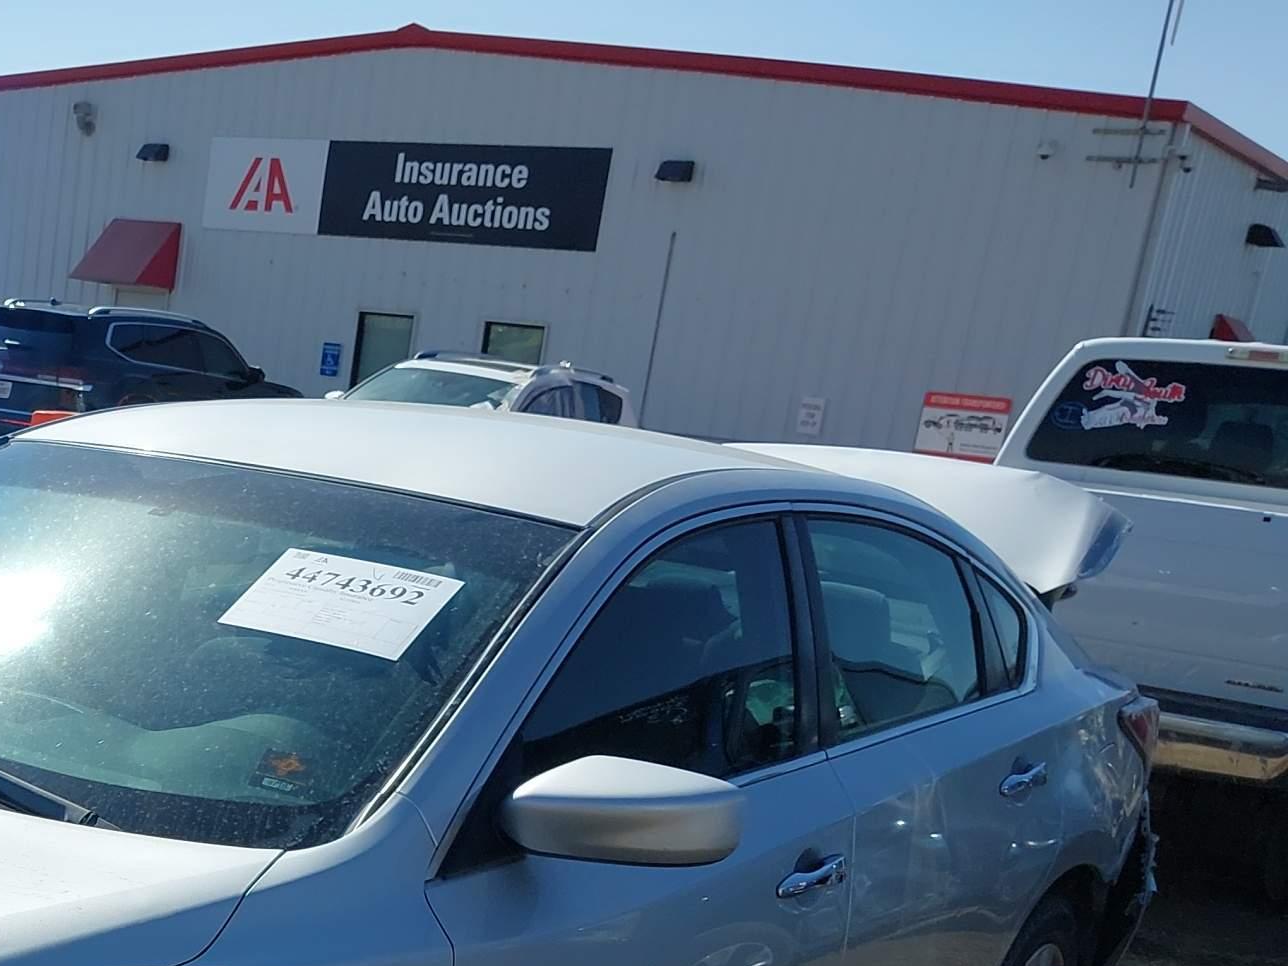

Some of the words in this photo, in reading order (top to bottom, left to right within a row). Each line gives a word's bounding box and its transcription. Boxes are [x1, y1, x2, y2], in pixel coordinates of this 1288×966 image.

[394, 152, 529, 188] Insurance
[362, 190, 424, 225] Auto
[429, 194, 551, 231] Auctions
[285, 566, 425, 606] 44743692
